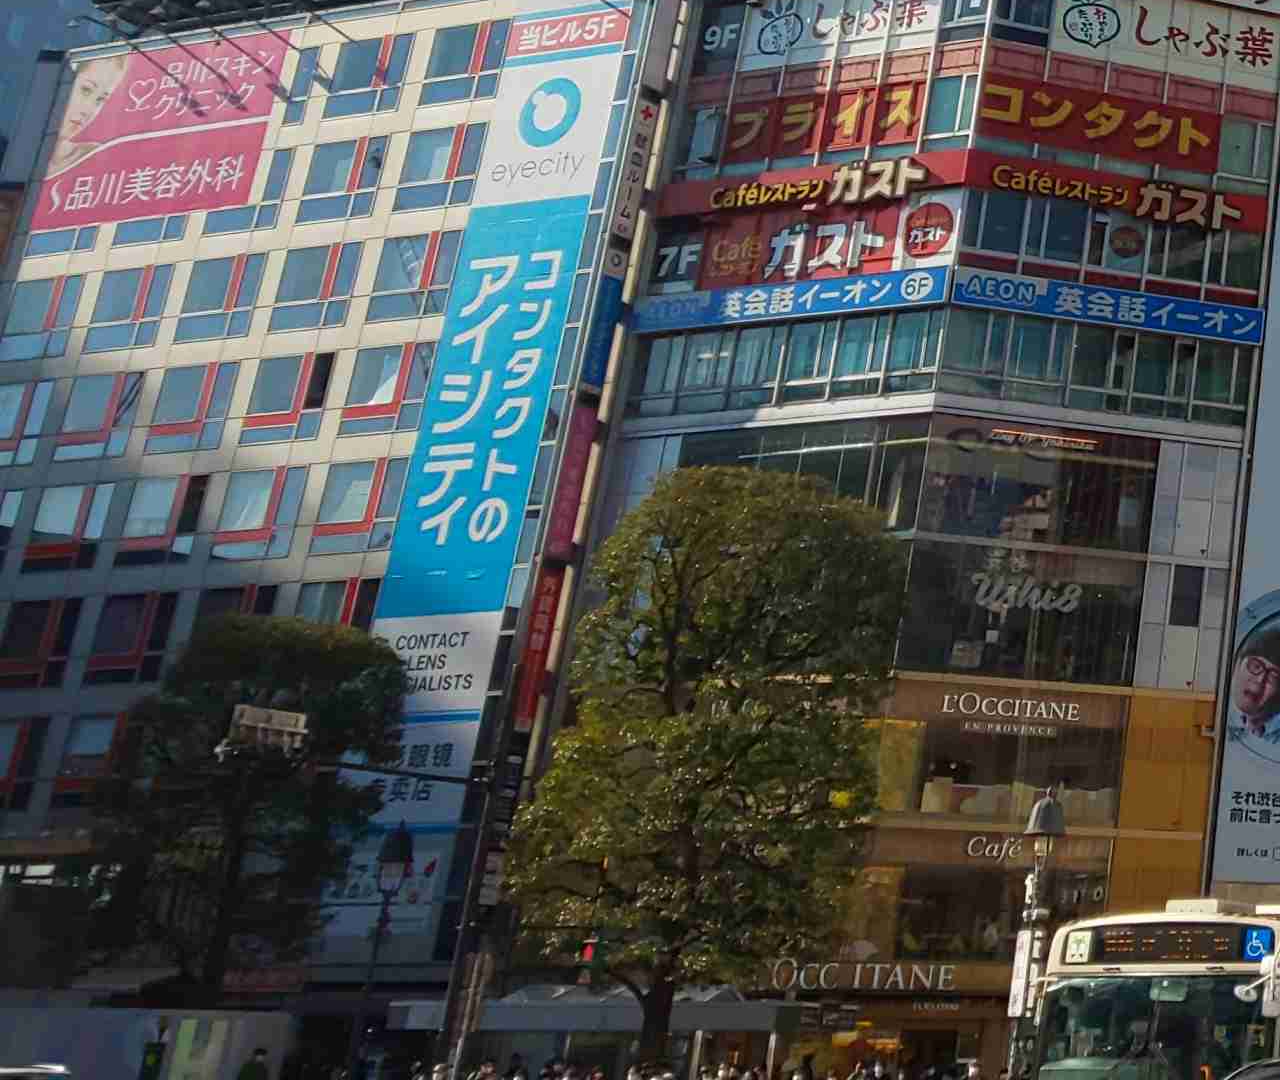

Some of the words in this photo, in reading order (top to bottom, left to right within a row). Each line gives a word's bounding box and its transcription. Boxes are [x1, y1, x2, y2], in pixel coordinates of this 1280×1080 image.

[518, 17, 617, 51] 当ビル5F
[703, 23, 739, 51] 9F
[1136, 6, 1274, 67] しゃぶ葉
[158, 48, 275, 89] 品川スキン
[154, 81, 256, 120] クリニック
[730, 88, 913, 150] プライス
[980, 83, 1211, 155] コンタクト
[64, 154, 245, 211] 品川美容外科
[490, 151, 585, 186] eyecity
[828, 157, 927, 206] ガスト
[1136, 184, 1241, 230] ガスト
[657, 243, 702, 277] 7F
[763, 221, 886, 280] ガスト
[721, 279, 893, 318] 英会話イーオン
[904, 277, 929, 296] 6F
[967, 276, 1036, 302] AEON
[1056, 287, 1257, 335] 英会話イーオン
[415, 256, 520, 545] アイシティ
[468, 249, 564, 543] コンタクトの
[395, 632, 470, 650] CONTACT
[407, 654, 447, 671] LENS
[406, 674, 473, 694] CIALISTS
[942, 692, 1081, 721] L'OCCITANE
[967, 836, 1023, 863] Café
